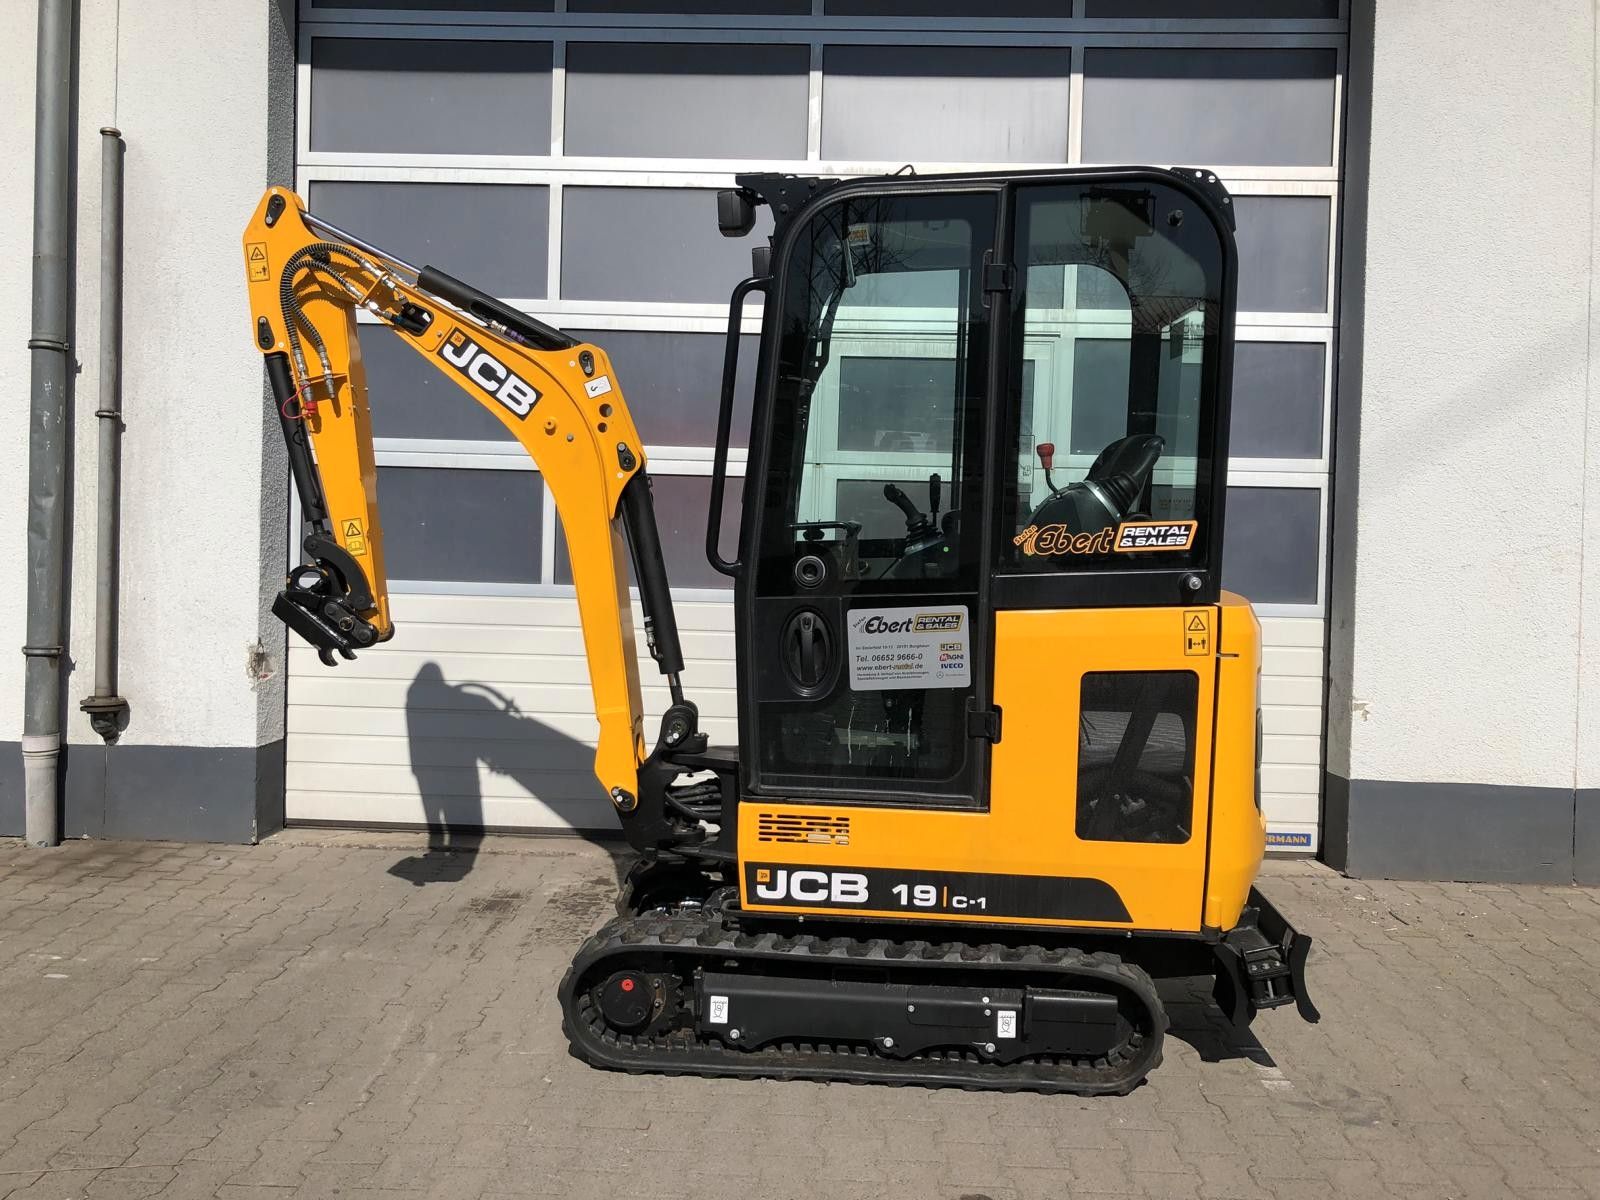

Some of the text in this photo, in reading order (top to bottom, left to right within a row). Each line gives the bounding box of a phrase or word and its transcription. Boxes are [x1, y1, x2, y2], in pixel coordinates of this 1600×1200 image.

[443, 343, 537, 416] JCB
[1013, 523, 1115, 555] Stefan Ebert
[1119, 535, 1187, 547] & SALES
[1123, 526, 1190, 537] RENTAL
[865, 616, 913, 635] Ebert
[856, 653, 923, 663] Tel. 06652 9666-0
[756, 869, 869, 903] JCB
[892, 884, 937, 907] 19
